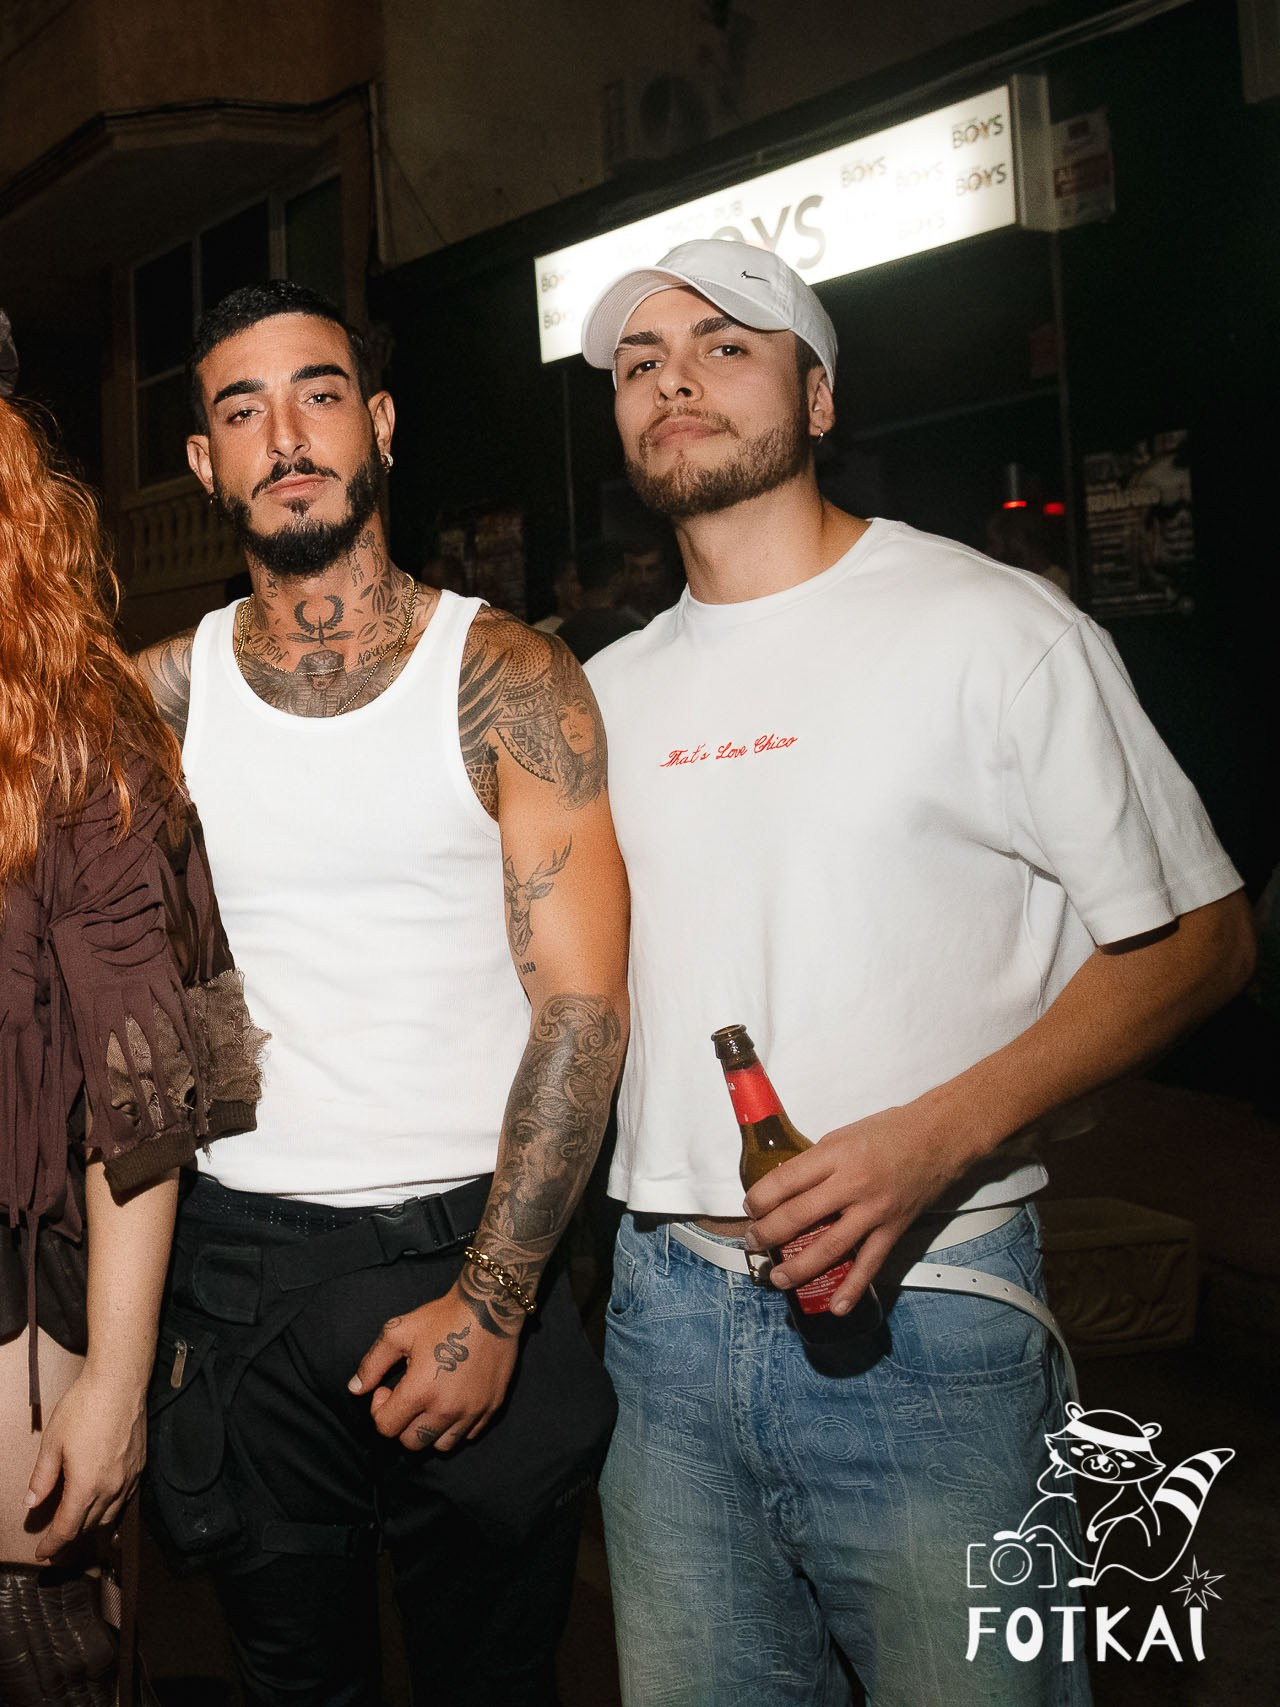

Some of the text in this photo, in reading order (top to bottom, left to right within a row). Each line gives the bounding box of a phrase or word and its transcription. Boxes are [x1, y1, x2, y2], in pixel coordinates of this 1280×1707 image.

[952, 114, 1004, 149] BOYS
[841, 156, 887, 189] BOYS
[955, 163, 1007, 197] BOYS
[710, 194, 827, 271] YS
[659, 733, 799, 767] That's Love Chico
